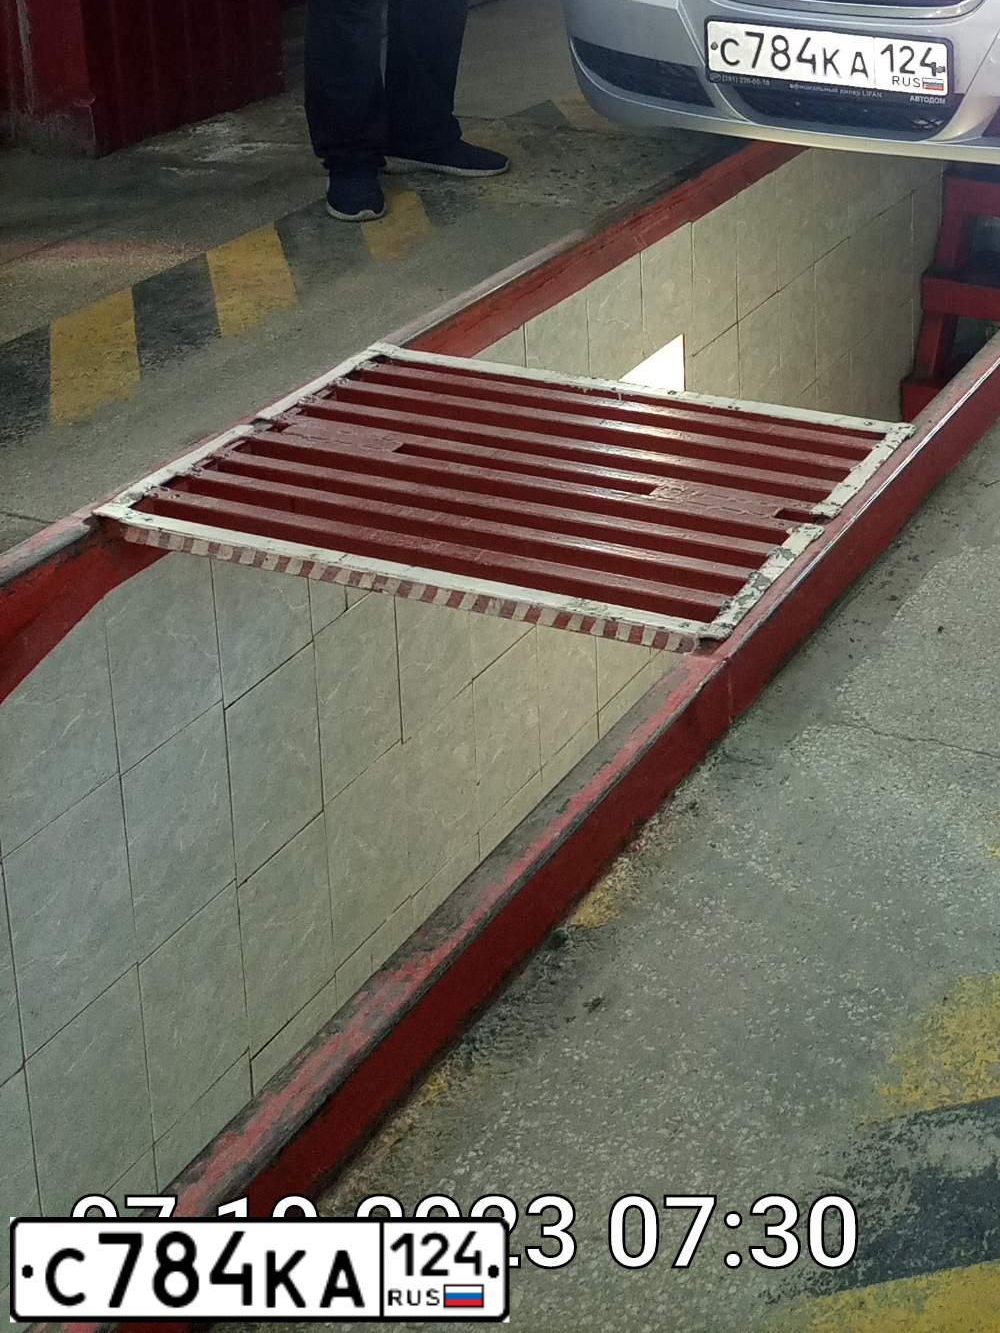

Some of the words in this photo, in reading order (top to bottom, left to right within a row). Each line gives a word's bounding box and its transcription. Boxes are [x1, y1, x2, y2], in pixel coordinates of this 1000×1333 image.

[720, 31, 869, 79] С784КА
[880, 43, 938, 77] 124
[891, 74, 922, 88] RUS
[910, 95, 946, 105] АВТОДОМ
